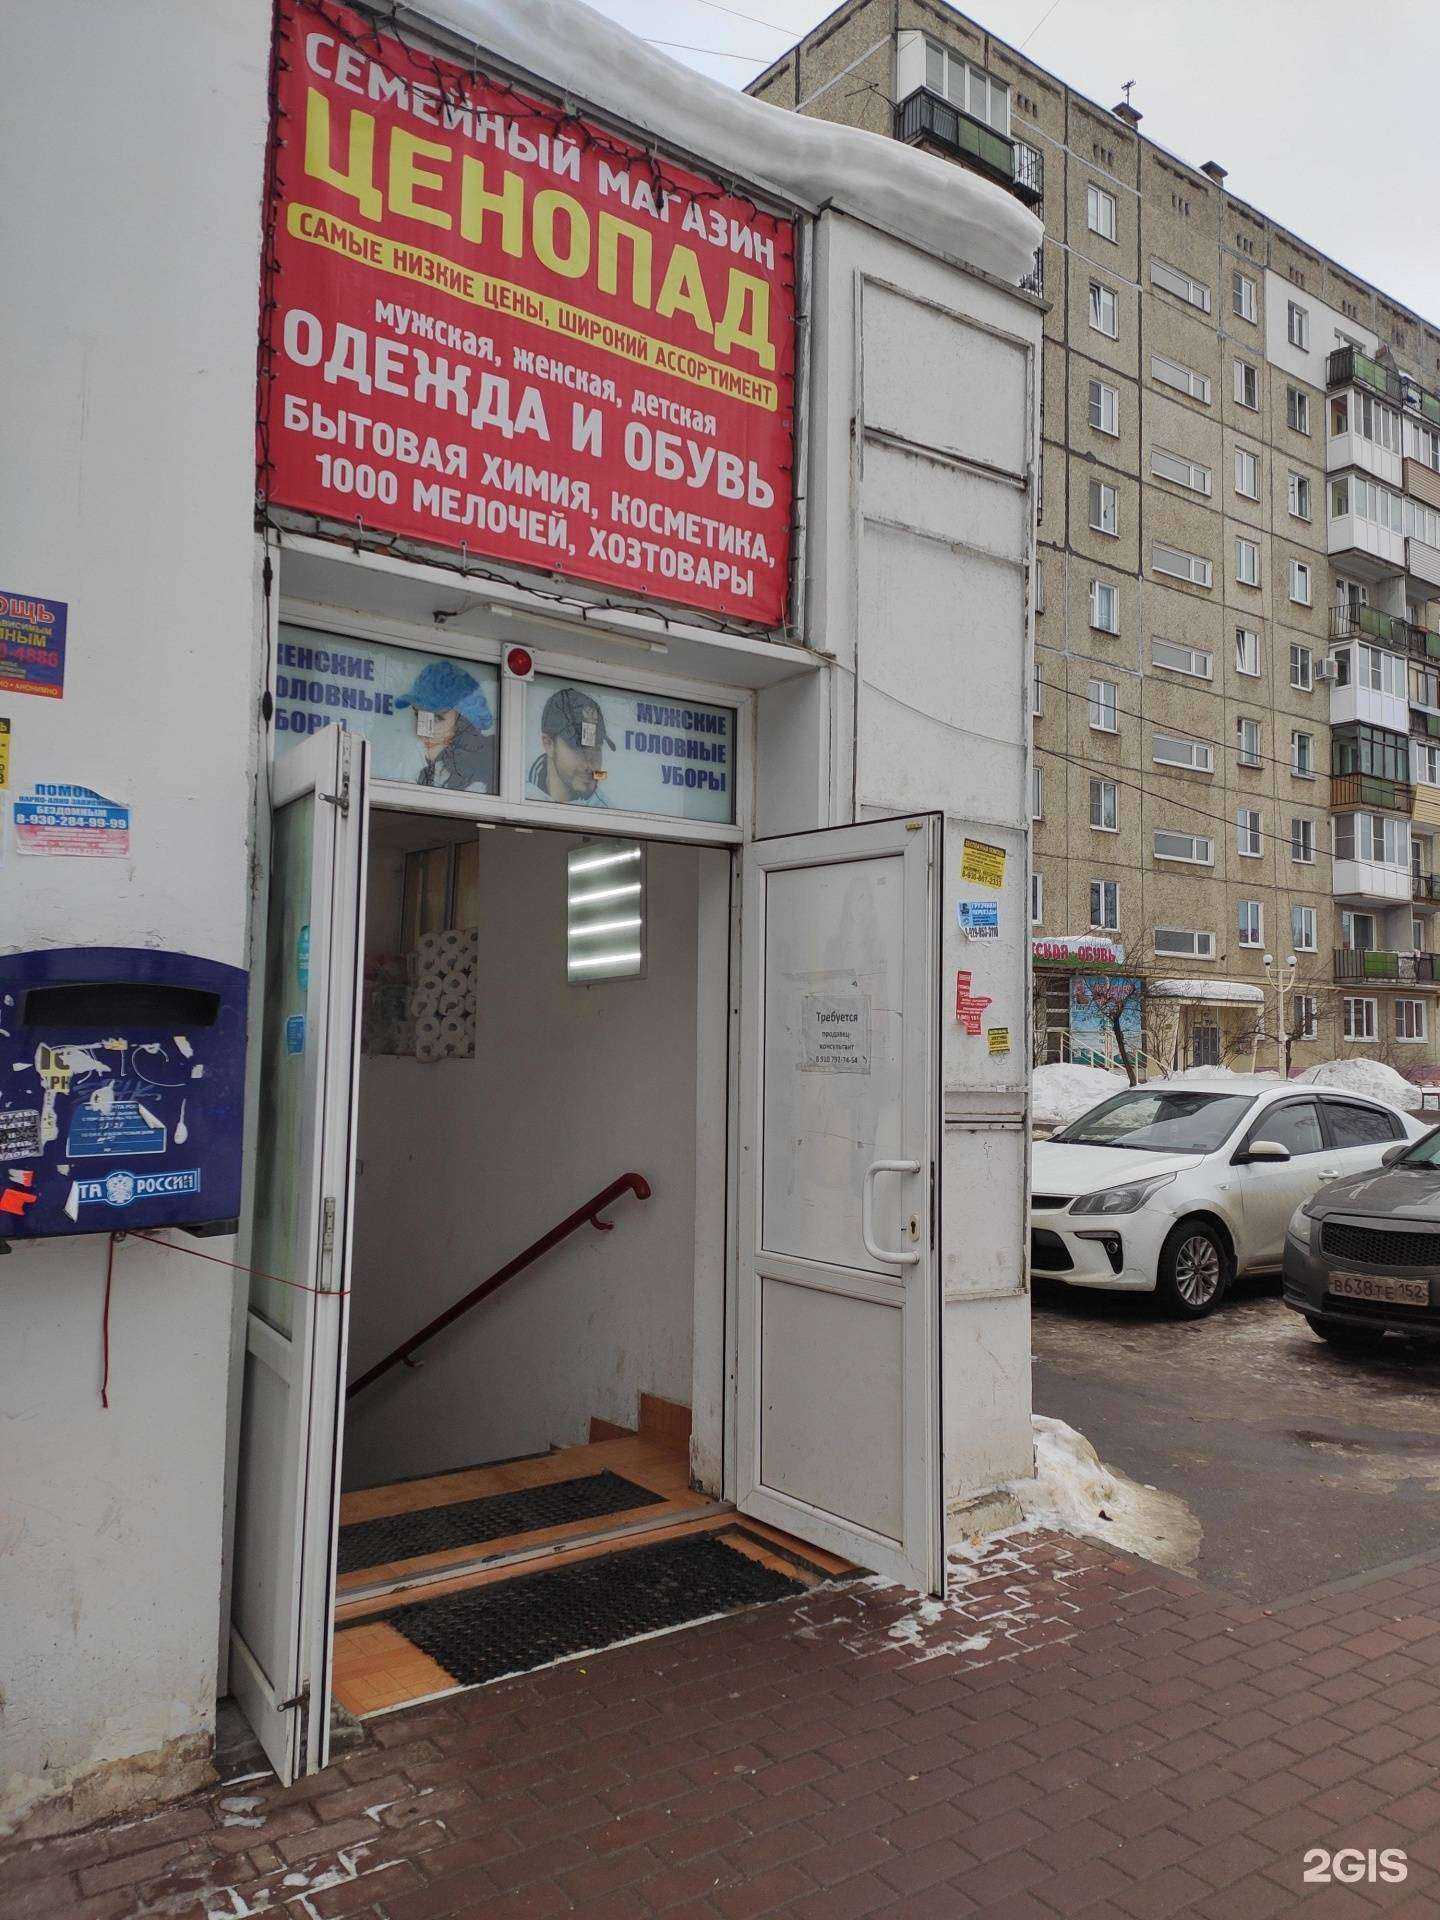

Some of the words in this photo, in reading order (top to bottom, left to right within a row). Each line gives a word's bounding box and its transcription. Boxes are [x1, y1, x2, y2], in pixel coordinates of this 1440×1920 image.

[304, 32, 581, 182] СЕМЕЙНЫЙ
[598, 160, 775, 270] МАГАЗИН
[304, 86, 776, 371] ЦЕНОПАД
[300, 212, 382, 264] САМЫЕ
[392, 245, 474, 299] НИЗКИЕ
[483, 272, 550, 327] ЦЕНЫ,
[558, 307, 648, 362] ШИРОКИЙ
[654, 346, 773, 405] АССОРТИМЕНТ
[375, 298, 502, 367] мужская,
[512, 345, 622, 409] женская,
[632, 389, 717, 436] детская
[283, 309, 551, 441] ОДЕЖДА
[571, 402, 604, 458] И
[624, 421, 775, 509] ОБУВЬ
[284, 393, 468, 479] БЫТОВАЯ
[481, 453, 599, 521] ХИМИЯ,
[610, 490, 776, 567] КОСМЕТИКА,
[315, 453, 397, 505] 1000
[413, 479, 576, 557] МЕЛОЧЕЙ,
[587, 528, 754, 598] ХОЗТОВАРЫ
[625, 730, 726, 763] ГОЛОВНЫЕ
[637, 703, 726, 735] МУЖСКИЕ
[661, 765, 726, 792] УБОРЫ
[36, 806, 107, 817] БЕЗДОМНЫМ
[816, 1010, 858, 1024] Требуется
[1078, 944, 1116, 962] ОБУВЬ
